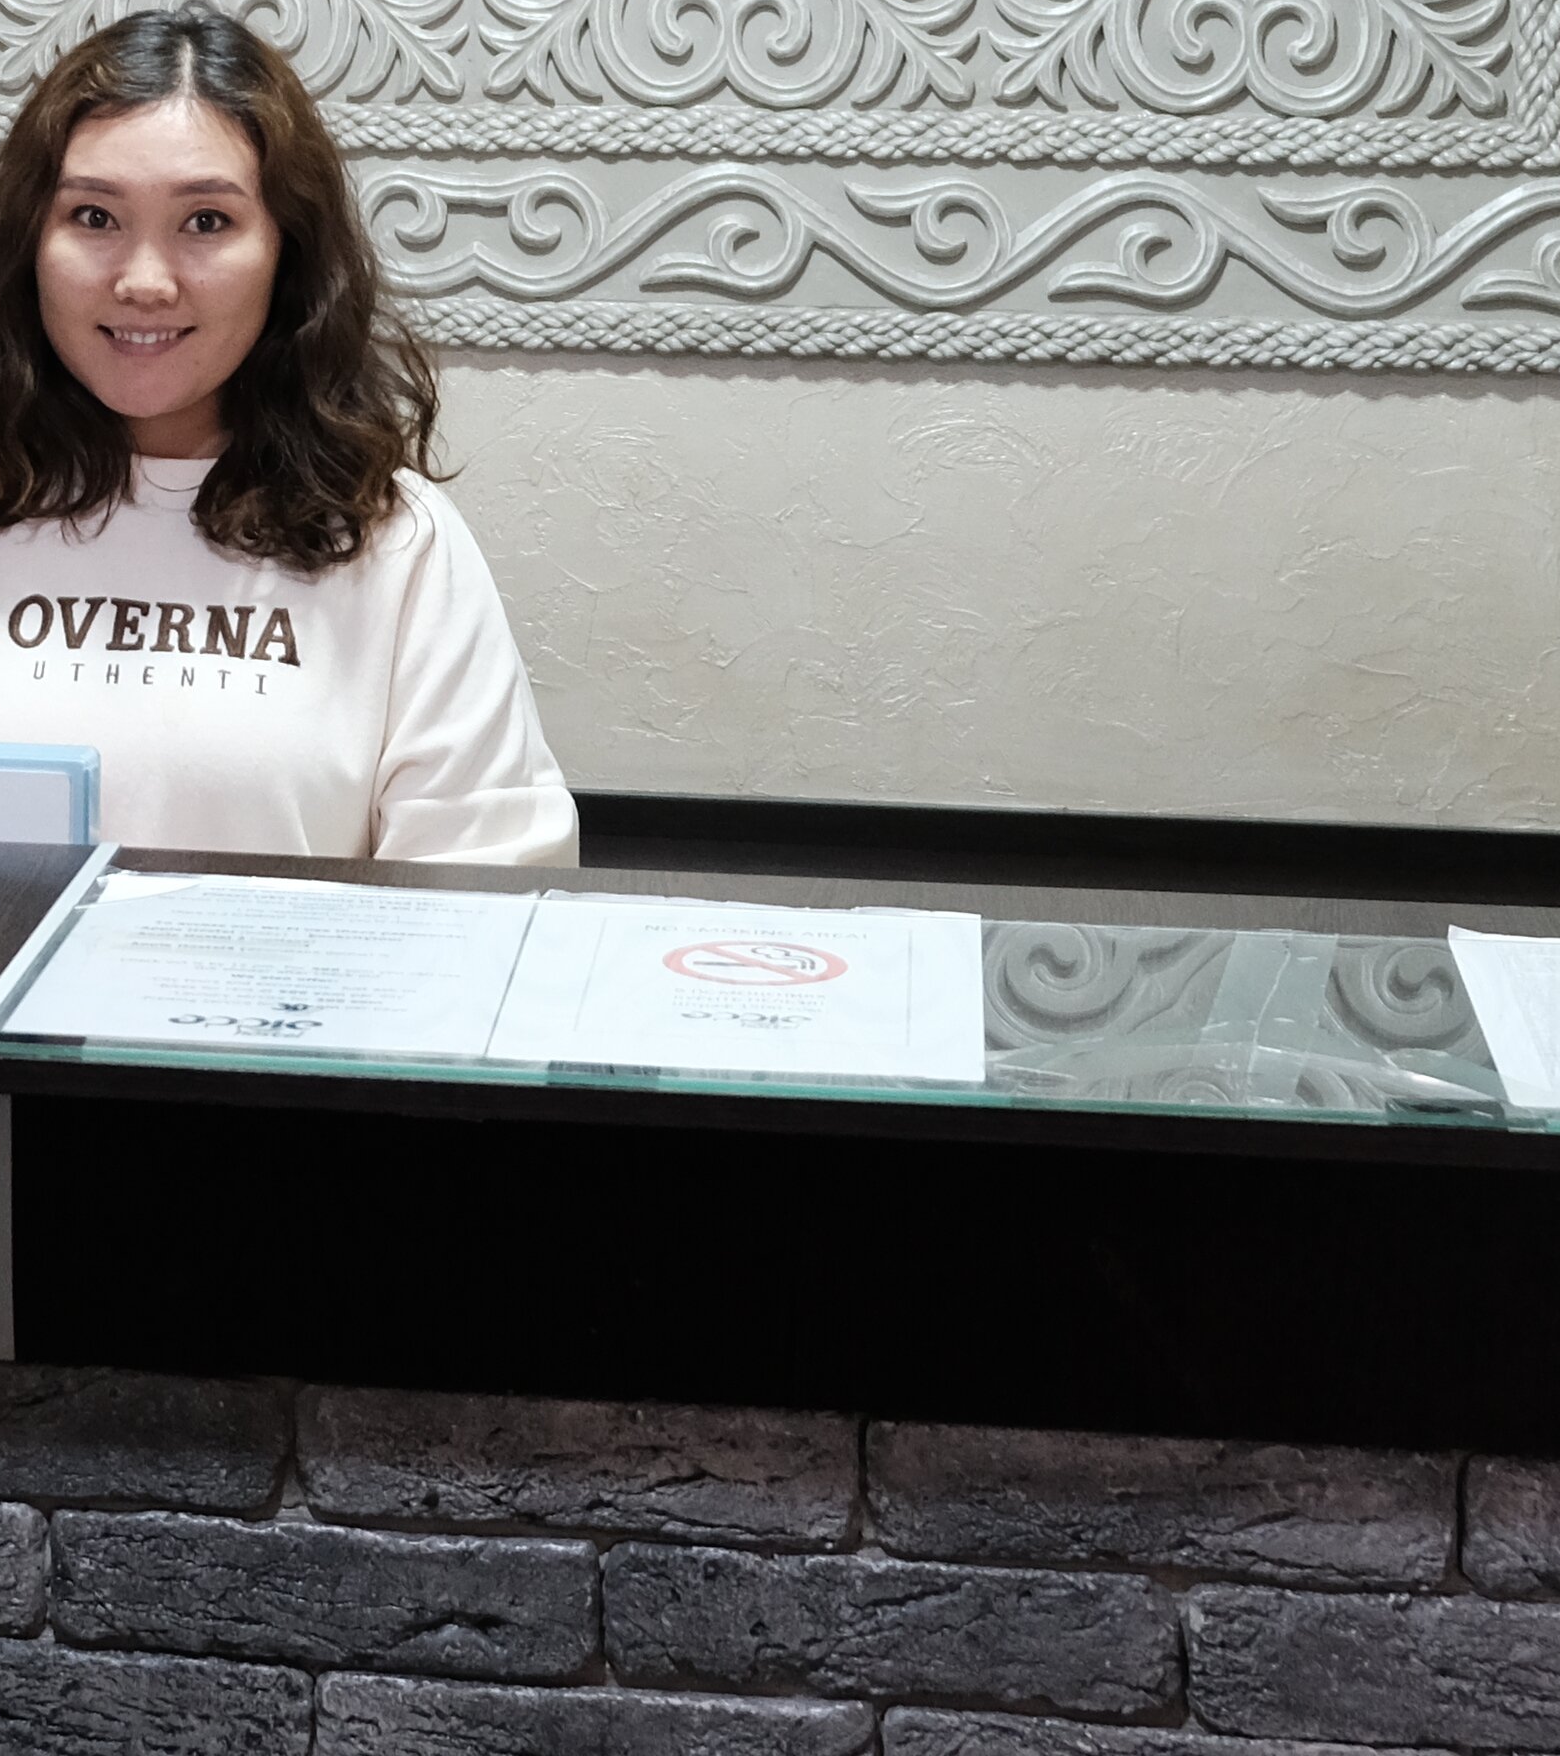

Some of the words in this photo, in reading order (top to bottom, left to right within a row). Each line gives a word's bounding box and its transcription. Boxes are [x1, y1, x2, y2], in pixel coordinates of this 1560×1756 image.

[8, 593, 301, 667] OVERNA
[32, 660, 268, 695] UTHENTI
[644, 924, 678, 932] NO
[686, 926, 794, 937] SMOKING
